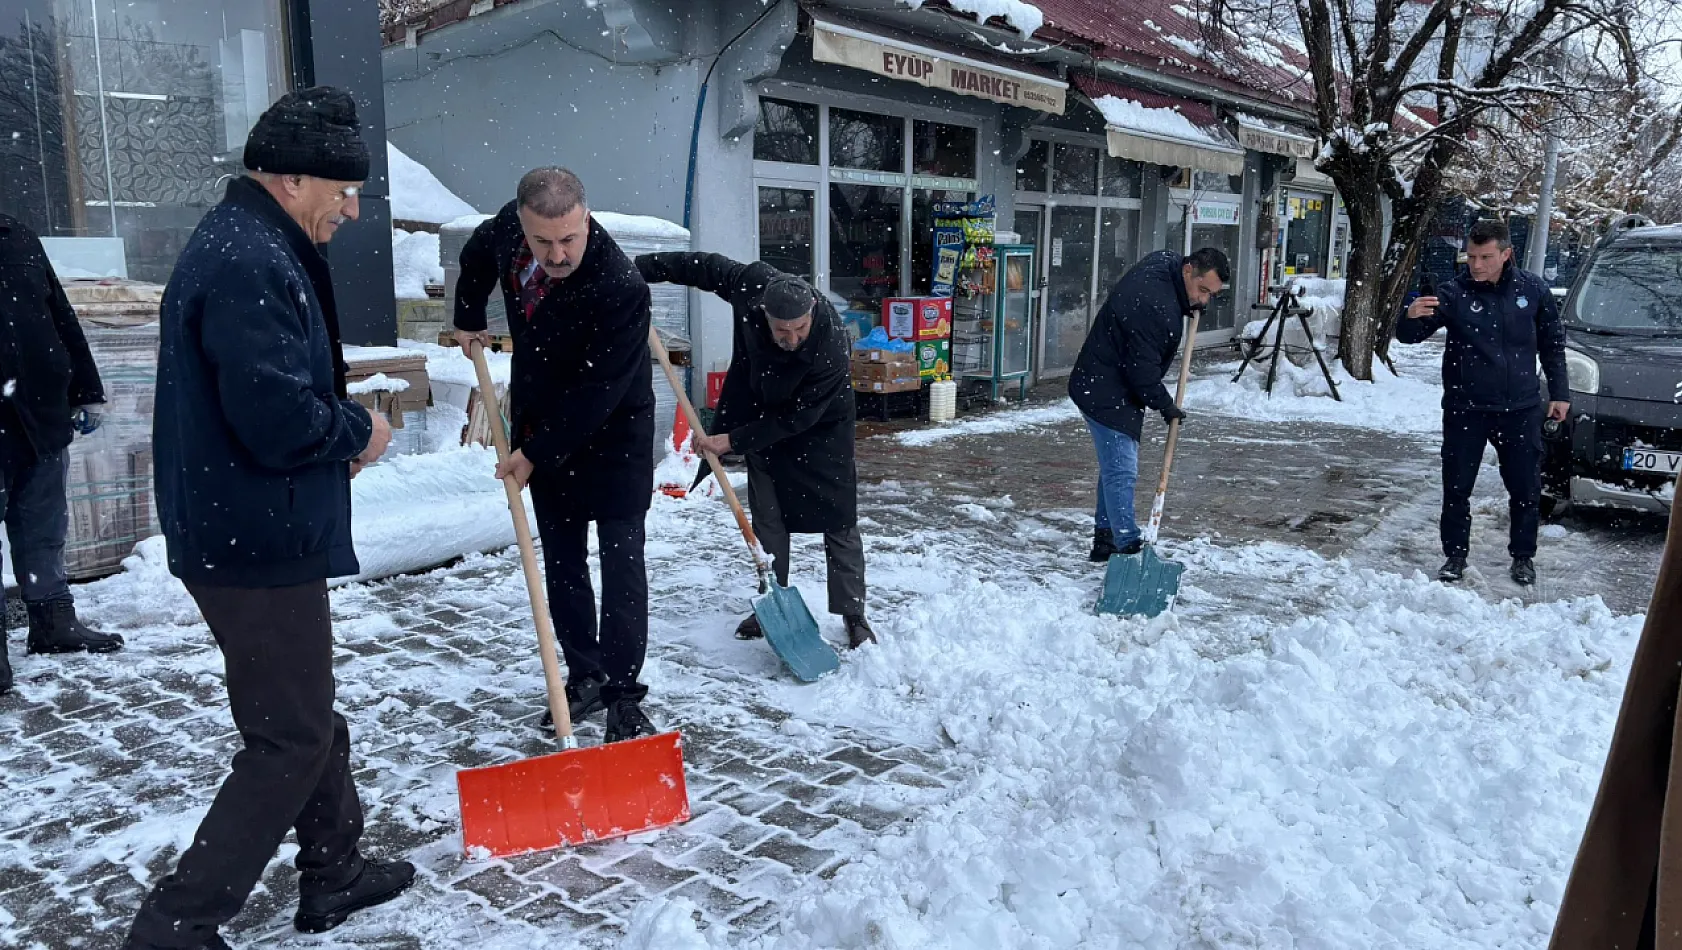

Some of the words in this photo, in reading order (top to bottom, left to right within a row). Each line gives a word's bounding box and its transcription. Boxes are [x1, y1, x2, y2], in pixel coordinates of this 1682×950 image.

[883, 52, 933, 79] EYÜP
[951, 69, 1020, 100] MARKET
[1633, 453, 1657, 469] 20
